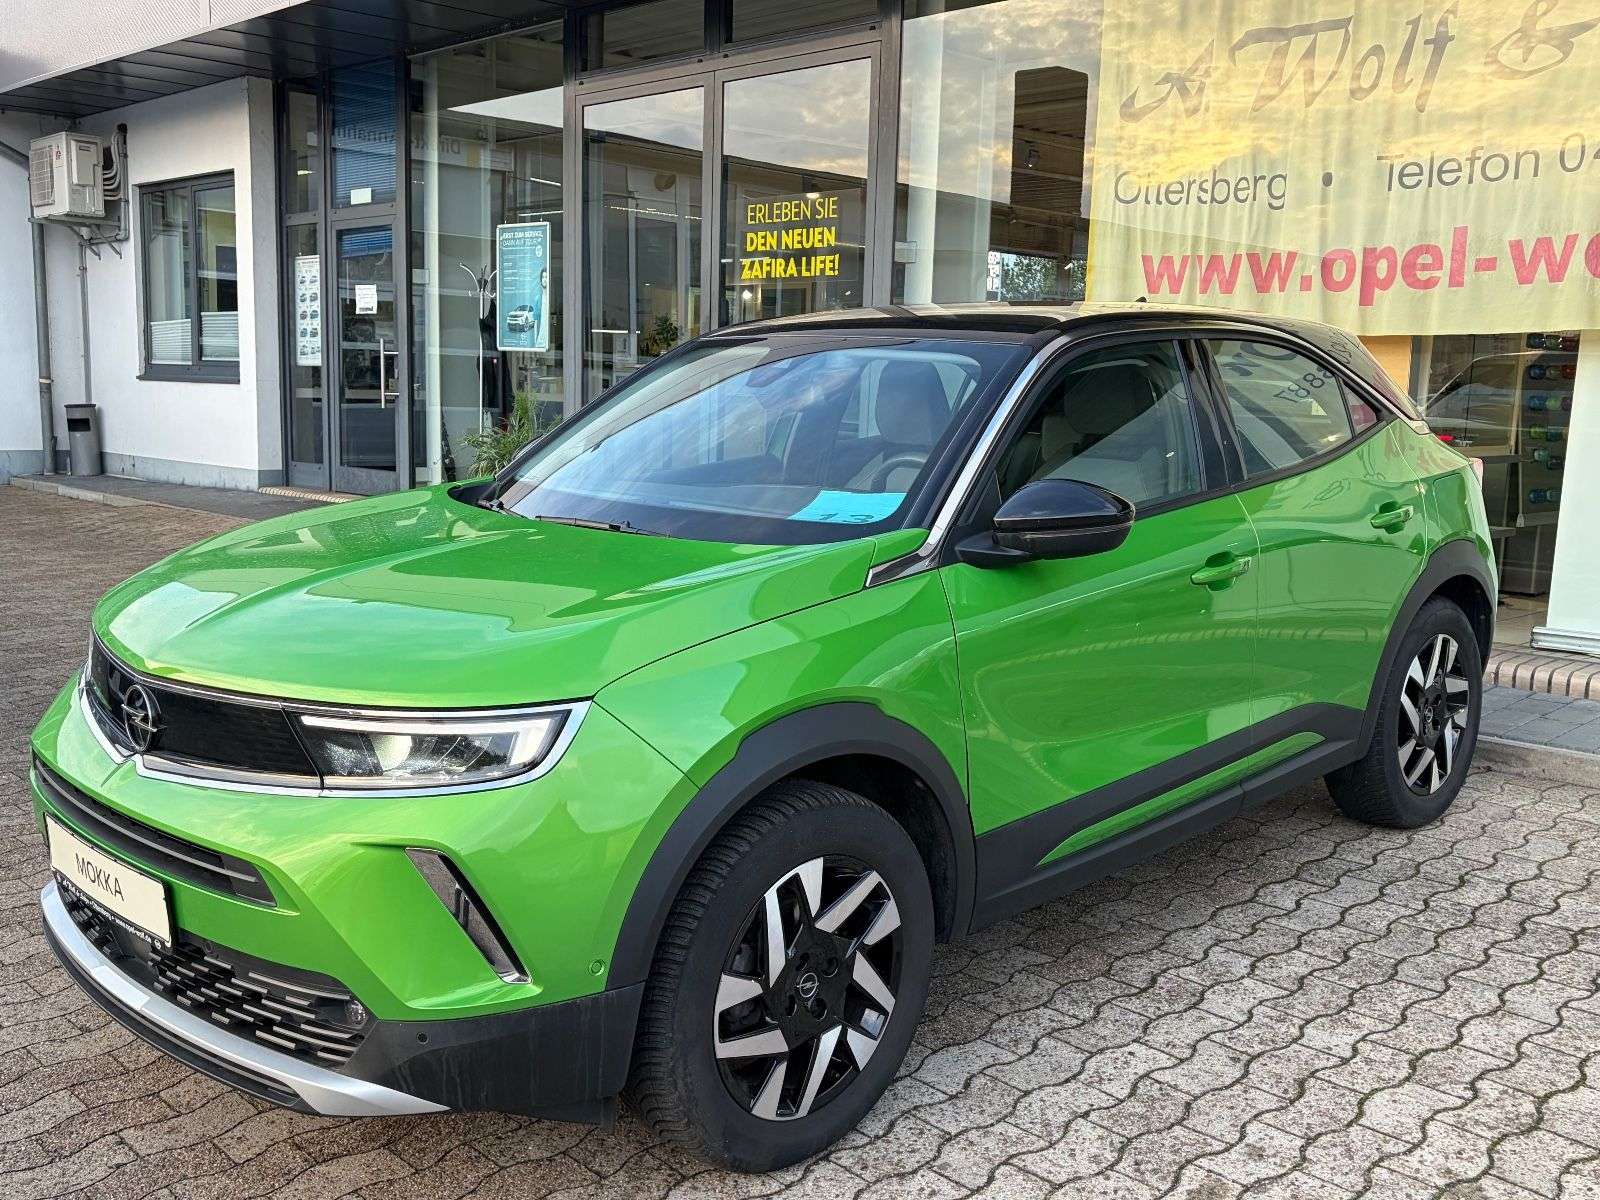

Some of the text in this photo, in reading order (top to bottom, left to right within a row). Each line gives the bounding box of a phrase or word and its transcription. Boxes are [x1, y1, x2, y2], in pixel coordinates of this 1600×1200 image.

[1228, 1, 1458, 113] Wolf
[1376, 146, 1541, 192] Telefon
[1559, 132, 1600, 172] 0
[747, 196, 839, 225] ERLEBEN SIE
[746, 226, 836, 252] DEN NEUEN
[741, 253, 840, 280] ZAFIRA LIFE!
[75, 852, 125, 902] MOKKA
